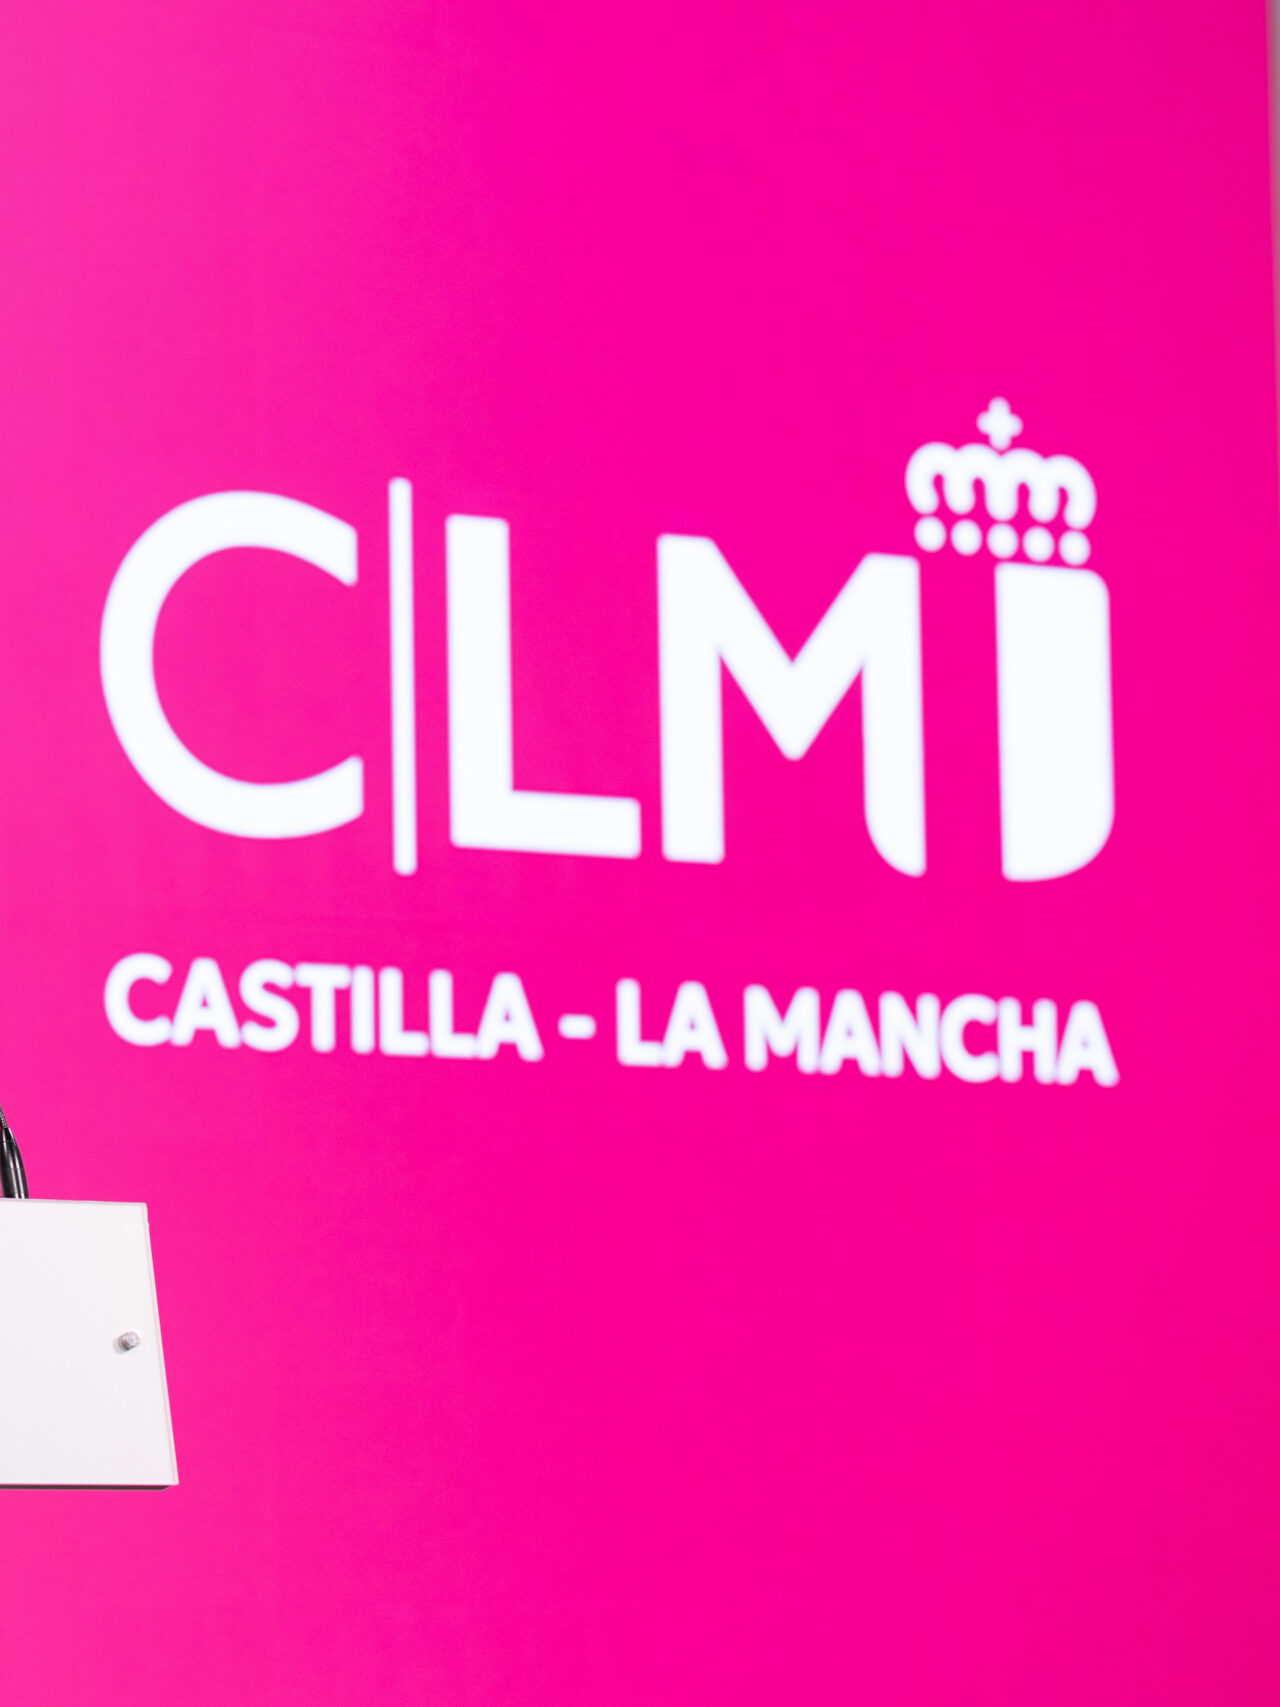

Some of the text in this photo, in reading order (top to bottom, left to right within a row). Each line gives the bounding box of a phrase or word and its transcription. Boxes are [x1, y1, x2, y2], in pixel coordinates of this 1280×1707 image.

[103, 952, 543, 1062] CASTILLA
[616, 978, 727, 1070] LA
[743, 984, 1118, 1087] MANCHA
